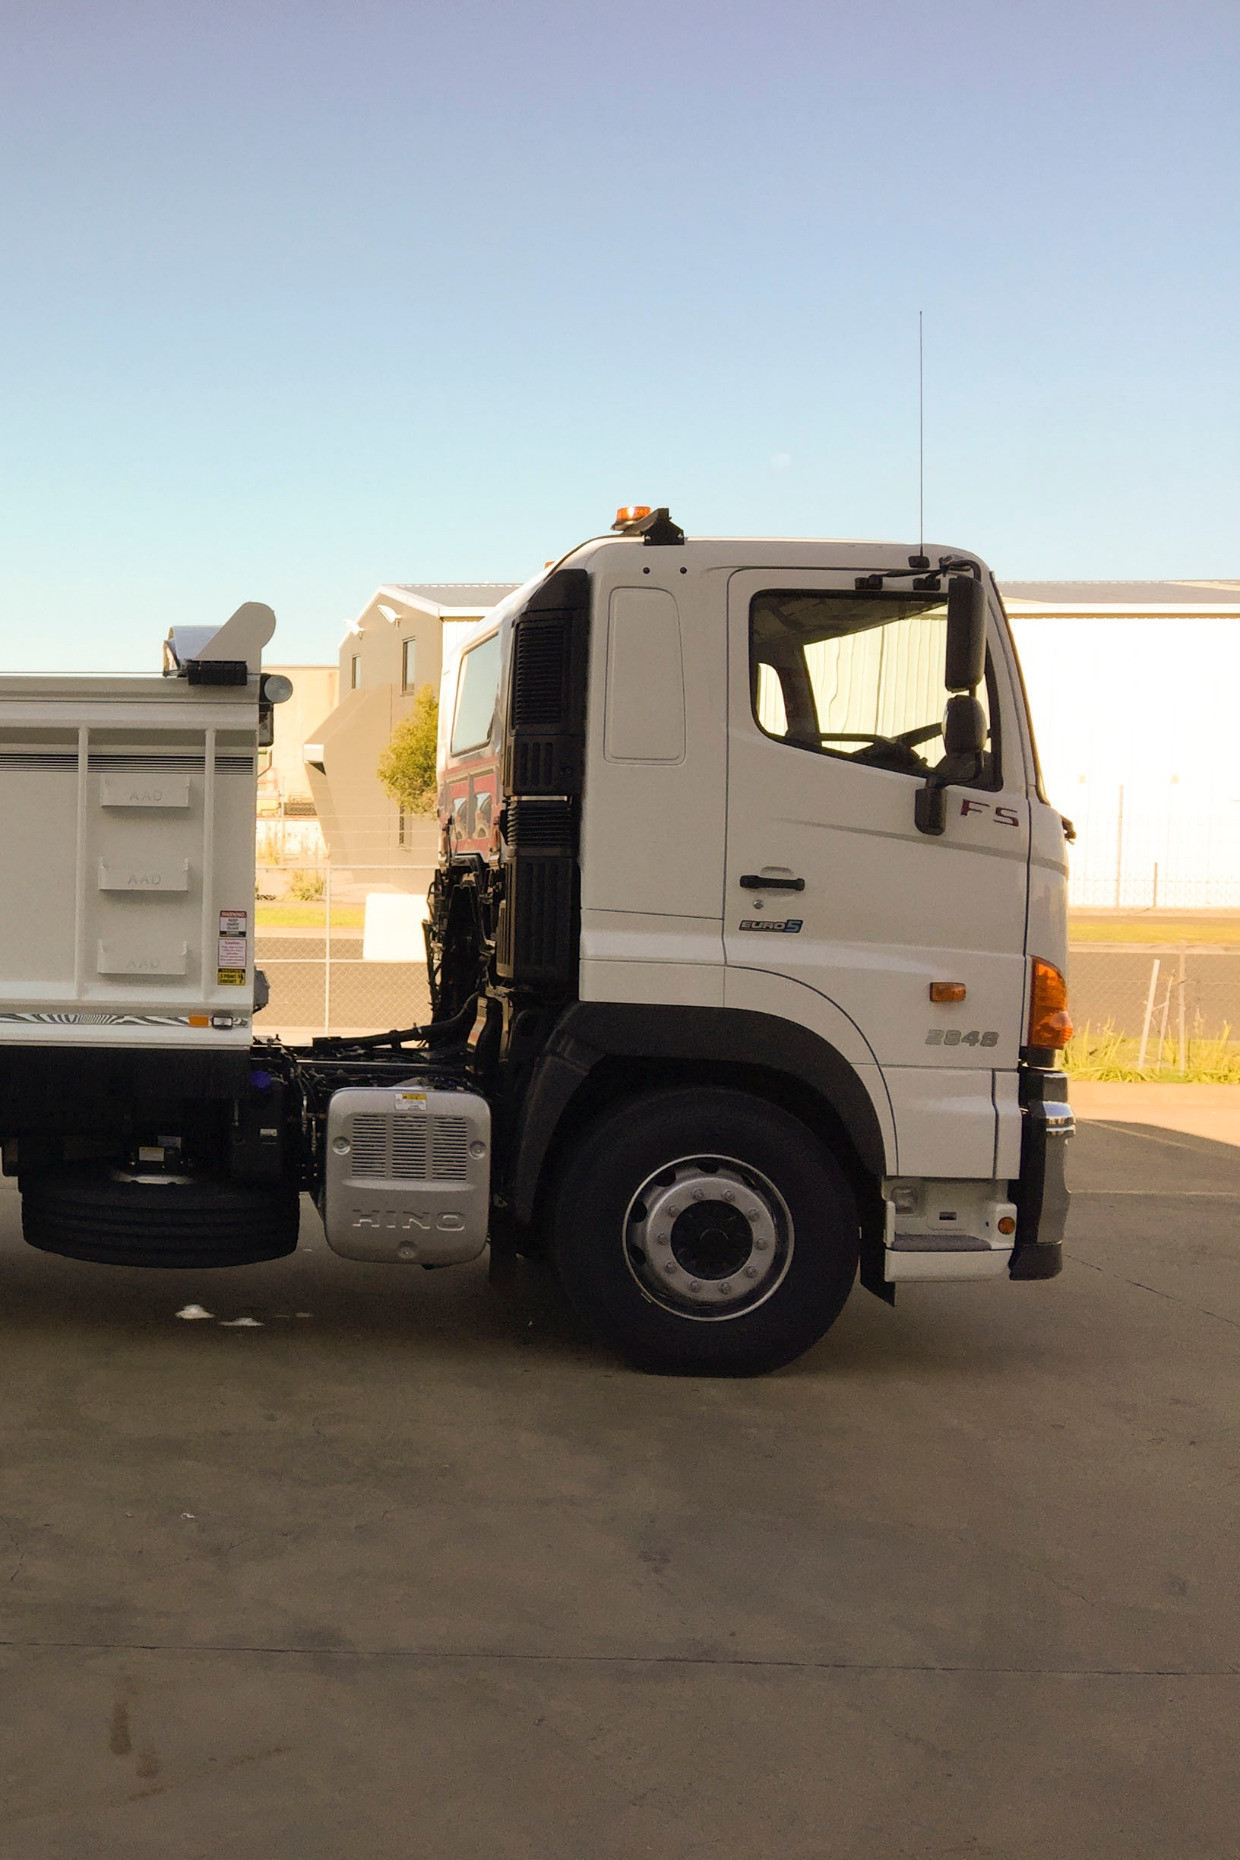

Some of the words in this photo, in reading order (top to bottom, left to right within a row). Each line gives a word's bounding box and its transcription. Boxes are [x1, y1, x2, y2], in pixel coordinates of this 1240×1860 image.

[961, 799, 1019, 827] FS
[127, 873, 162, 885] AAD
[352, 1209, 465, 1231] HINO
